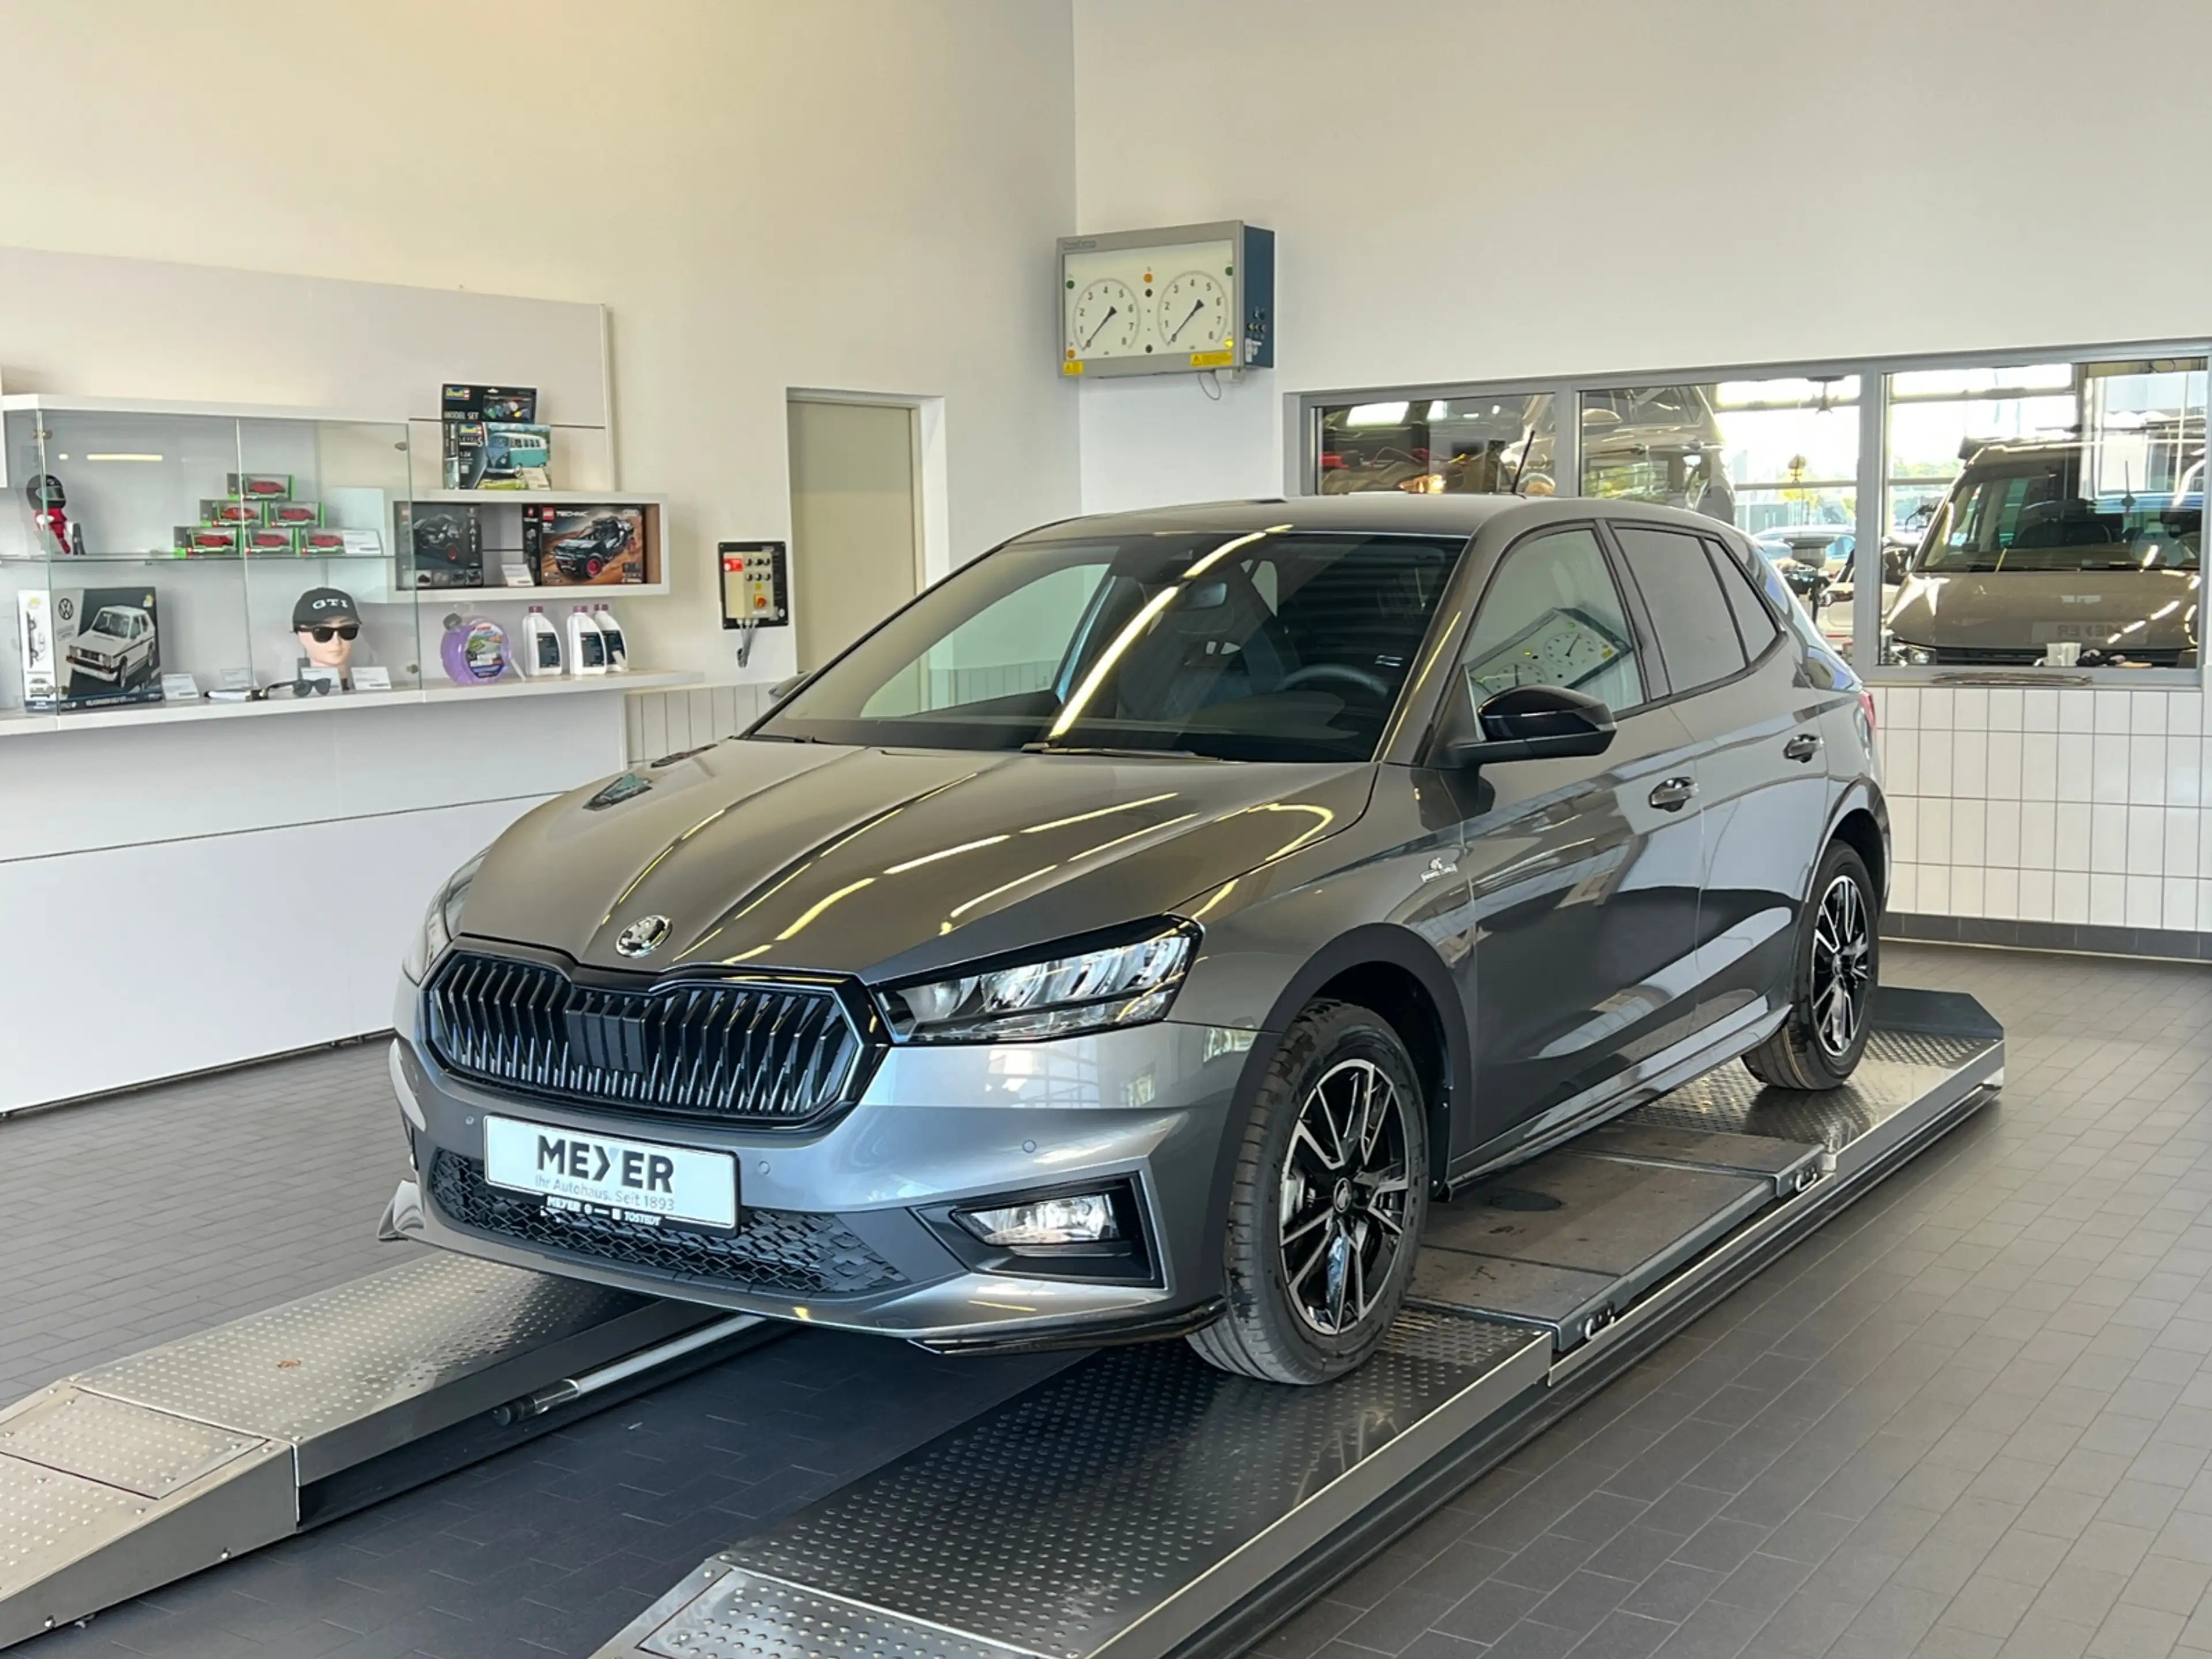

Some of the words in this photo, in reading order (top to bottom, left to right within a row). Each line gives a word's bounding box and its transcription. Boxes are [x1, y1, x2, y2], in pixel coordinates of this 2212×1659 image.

[1189, 279, 1195, 287] 4
[1206, 282, 1211, 291] 5
[1119, 289, 1124, 298] 5
[1173, 285, 1179, 294] 3
[1088, 291, 1093, 301] 3
[1164, 301, 1170, 310] 2
[1216, 297, 1221, 306] 6
[1080, 308, 1085, 316] 2
[1128, 304, 1134, 313] 6
[1164, 320, 1169, 328] 1
[1217, 315, 1222, 325] 7
[1128, 322, 1134, 331] 7
[1121, 336, 1127, 346] 8
[467, 411, 479, 420] SET
[312, 597, 349, 609] GTI
[537, 1134, 674, 1194] MEYER
[535, 1174, 551, 1189] Ihr
[553, 1179, 612, 1202] Autohaus.
[615, 1190, 641, 1206] Seit
[644, 1195, 675, 1211] 1893
